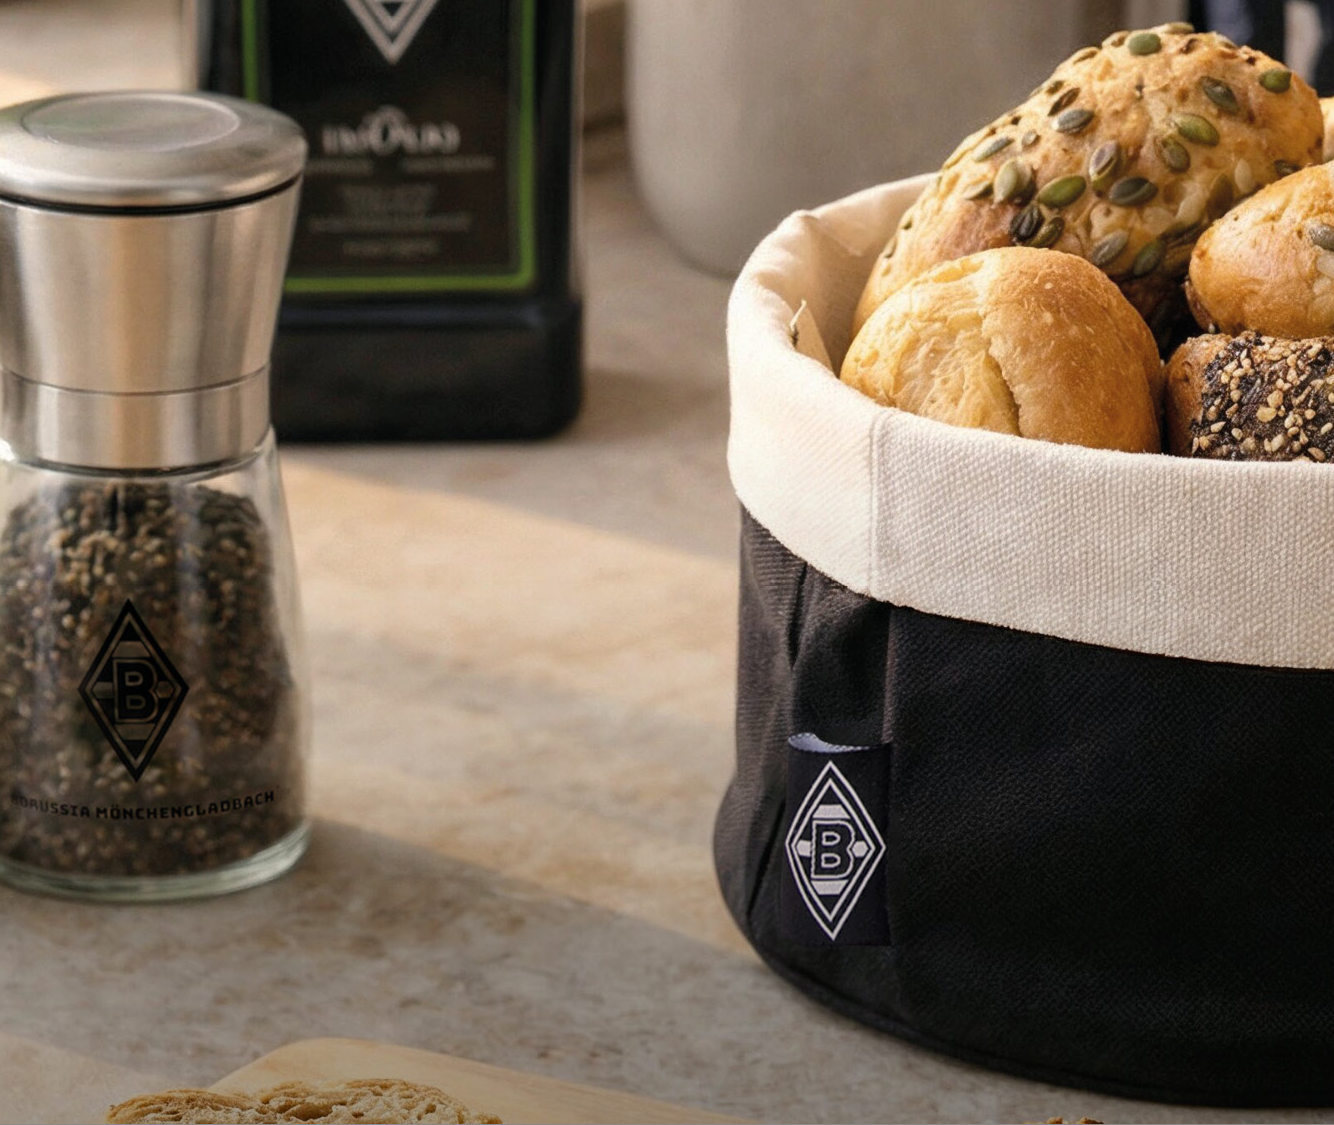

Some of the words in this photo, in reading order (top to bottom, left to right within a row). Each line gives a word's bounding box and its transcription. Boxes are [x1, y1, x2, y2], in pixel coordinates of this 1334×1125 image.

[112, 658, 159, 723] B
[96, 790, 275, 820] MÖNCHENGLADBACH
[810, 819, 855, 879] B
